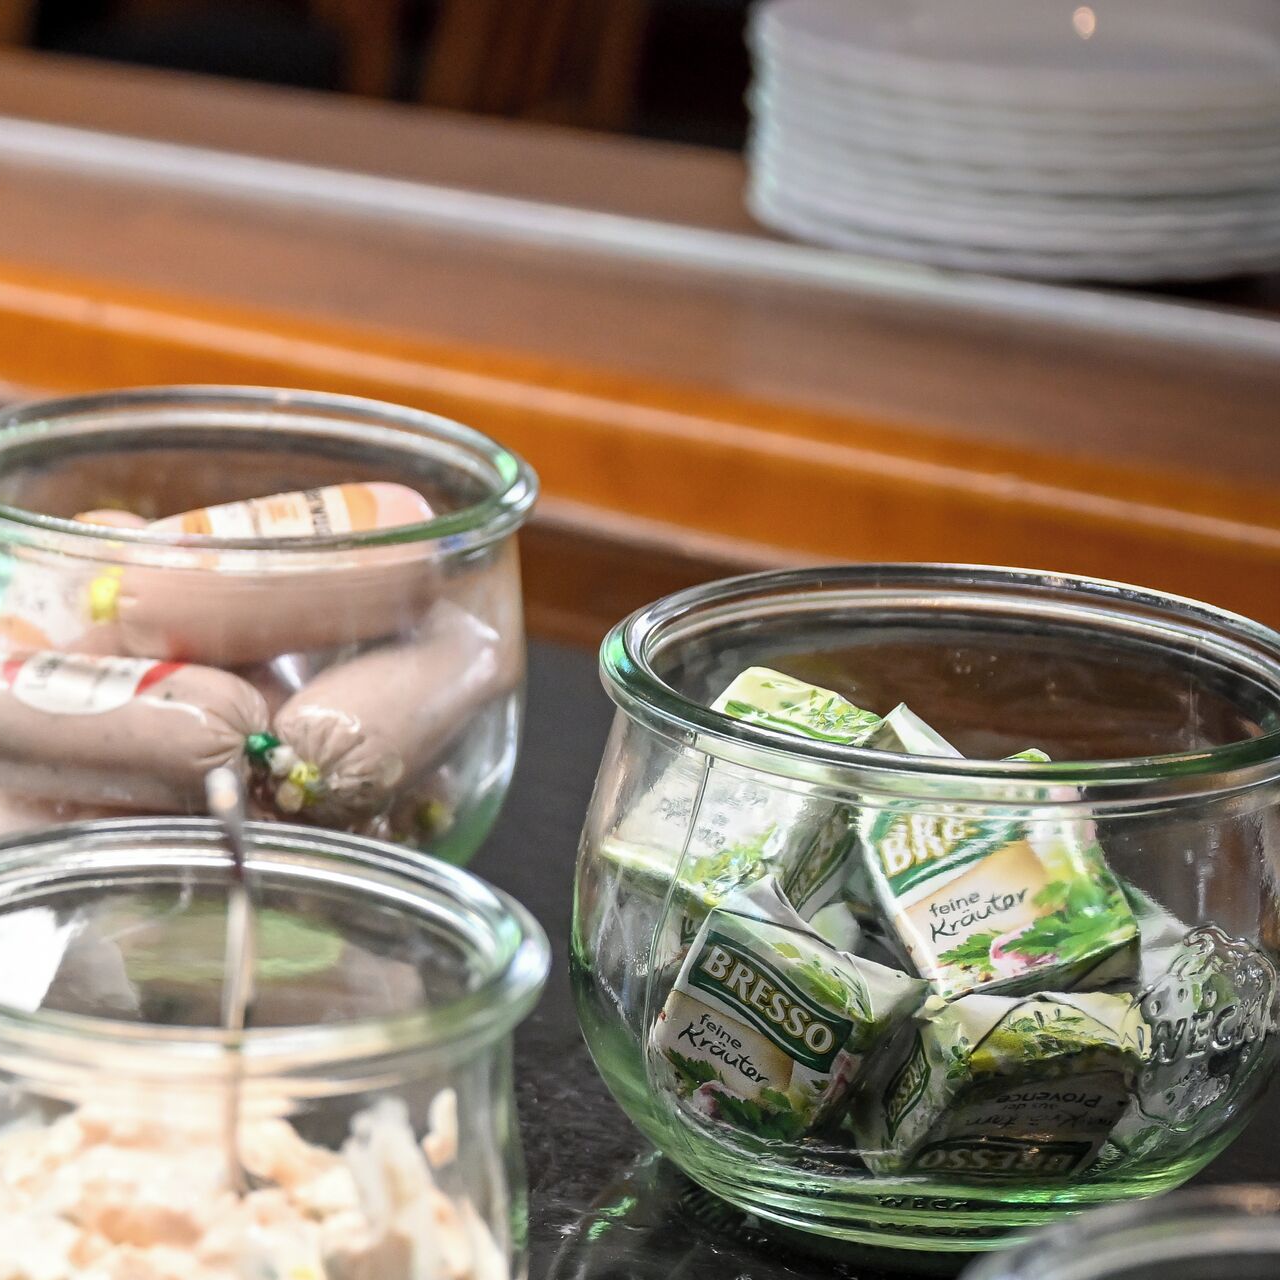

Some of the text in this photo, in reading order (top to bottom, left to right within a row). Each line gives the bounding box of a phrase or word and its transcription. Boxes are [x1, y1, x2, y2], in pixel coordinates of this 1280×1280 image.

[929, 891, 981, 919] feine
[929, 887, 1030, 944] Kräuter
[701, 945, 836, 1056] BRESSO
[677, 1021, 770, 1084] Kräuter
[699, 1013, 743, 1050] feine
[995, 1091, 1104, 1108] Provence
